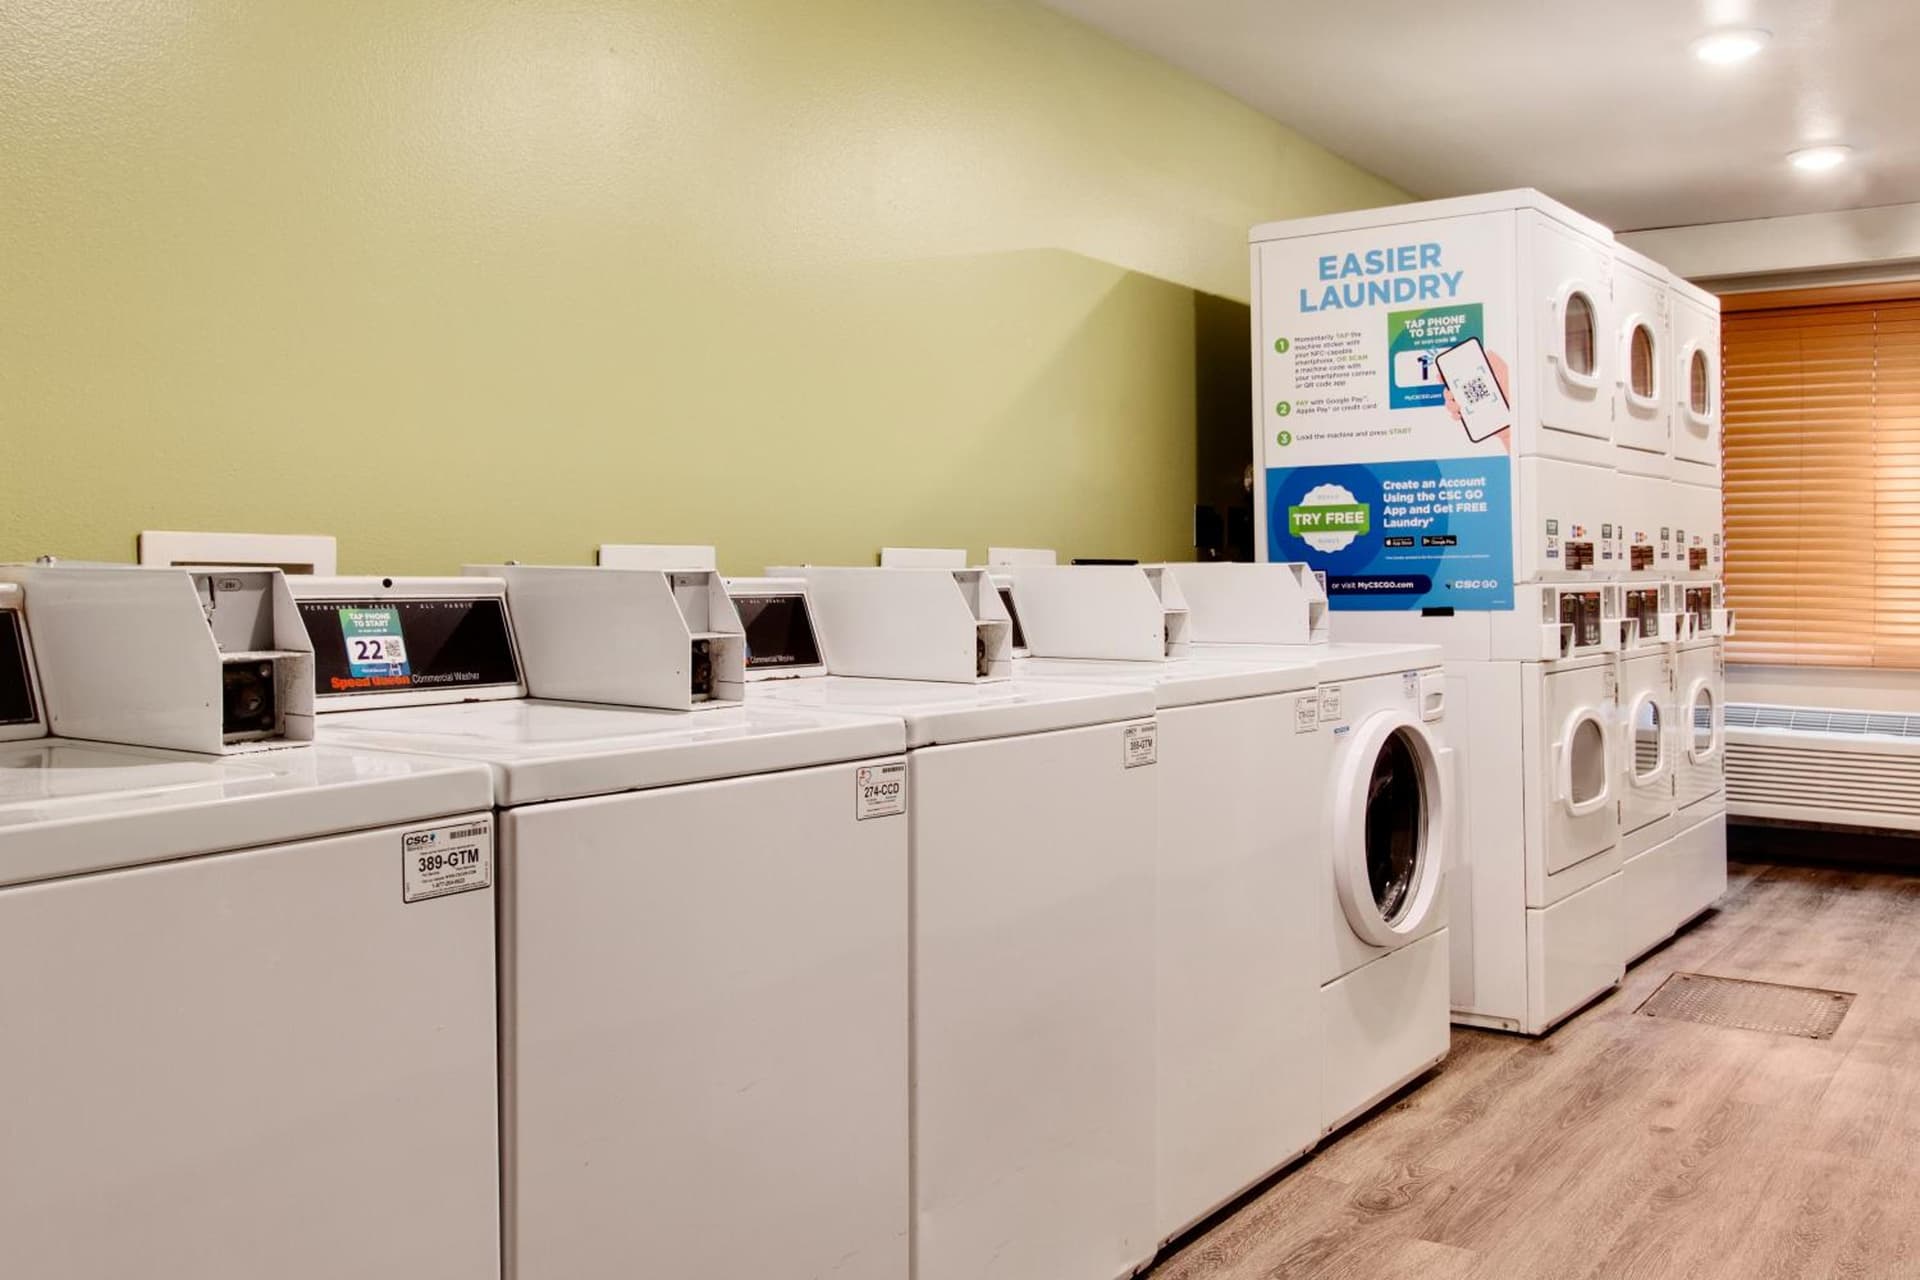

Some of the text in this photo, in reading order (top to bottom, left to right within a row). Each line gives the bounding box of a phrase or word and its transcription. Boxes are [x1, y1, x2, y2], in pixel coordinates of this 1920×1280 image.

[1319, 243, 1442, 281] EASIER
[1300, 271, 1464, 313] LAUNDRY
[1405, 314, 1466, 329] TAP PHONE
[1409, 325, 1461, 338] TO START
[1417, 355, 1428, 380] 1
[1311, 372, 1350, 380] smartphone
[1326, 397, 1349, 405] Google
[1296, 406, 1315, 414] Apple
[1383, 477, 1486, 490] Create an Account
[1383, 489, 1483, 503] Using the CSC GO
[1383, 502, 1488, 516] App and Get FREE
[1293, 511, 1365, 525] TRY FREE
[1357, 581, 1414, 590] MyCSCGO.com
[1455, 579, 1498, 588] CSC GO
[364, 612, 391, 620] PHONE
[354, 640, 383, 660] 22
[411, 672, 453, 684] Commercial
[453, 670, 480, 681] Washer
[864, 783, 899, 798] 274-CCD
[406, 835, 428, 846] CSC
[418, 848, 479, 872] 389-GTM
